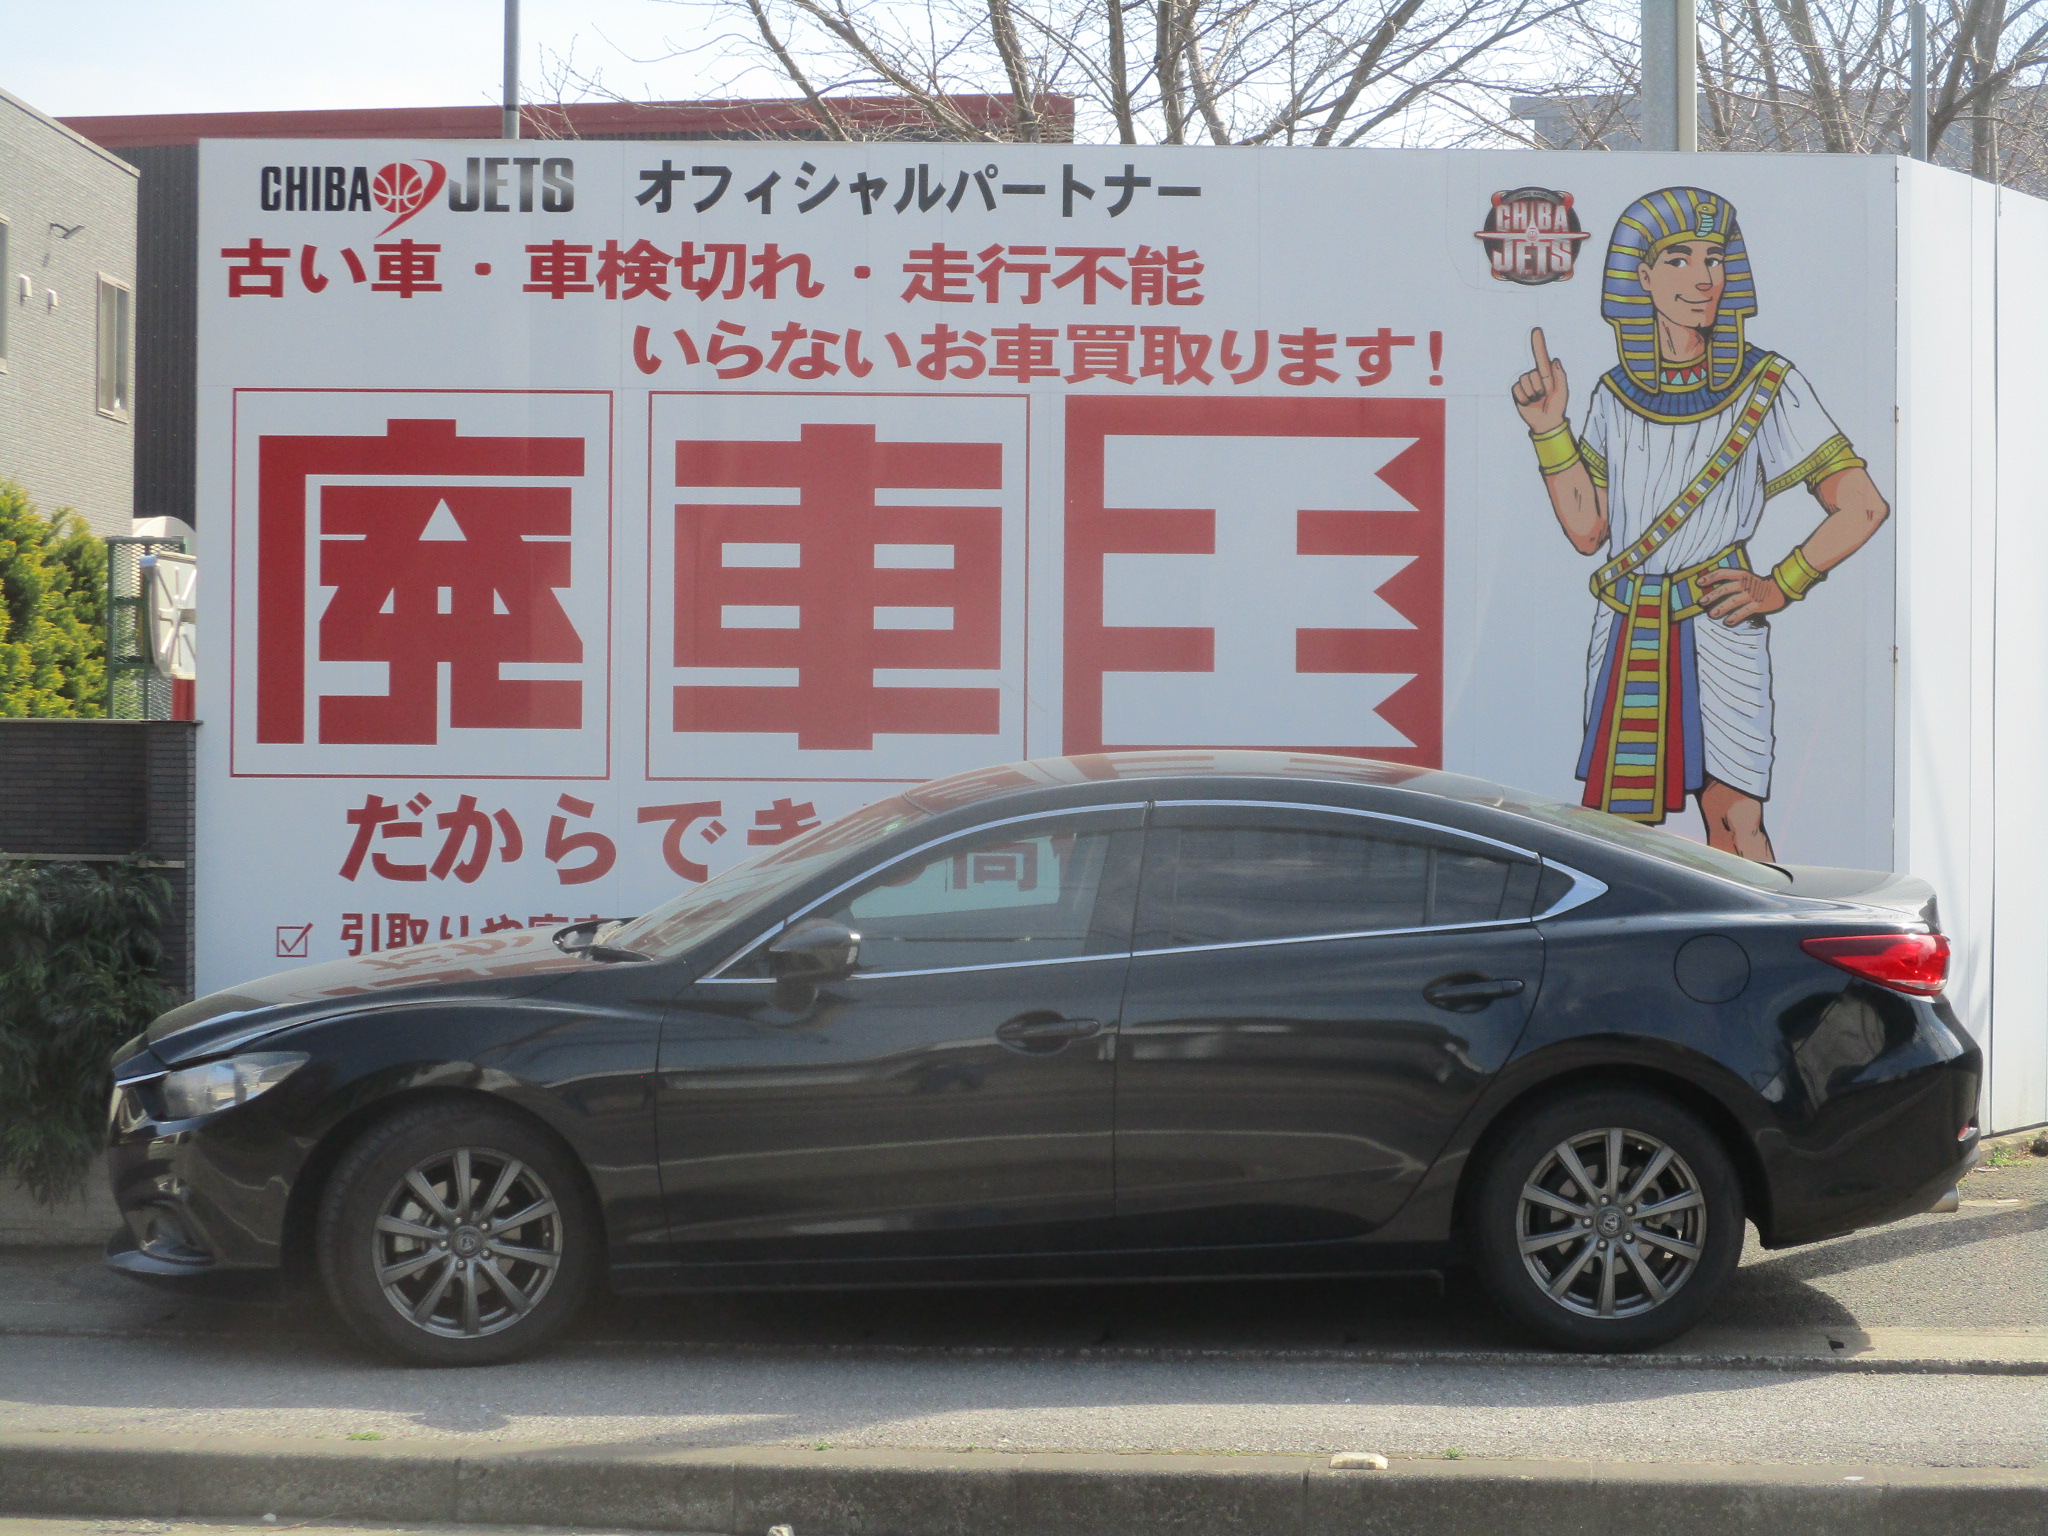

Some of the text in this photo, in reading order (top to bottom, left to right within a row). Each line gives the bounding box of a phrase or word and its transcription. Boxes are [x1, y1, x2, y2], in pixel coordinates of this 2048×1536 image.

[260, 156, 575, 213] CHIBA JETS
[636, 160, 1202, 218] オフィシャルパートナー
[1495, 201, 1569, 232] CHIBA
[220, 237, 1205, 306] 古い車・車検切れ・走行不能
[1492, 236, 1572, 276] JETS
